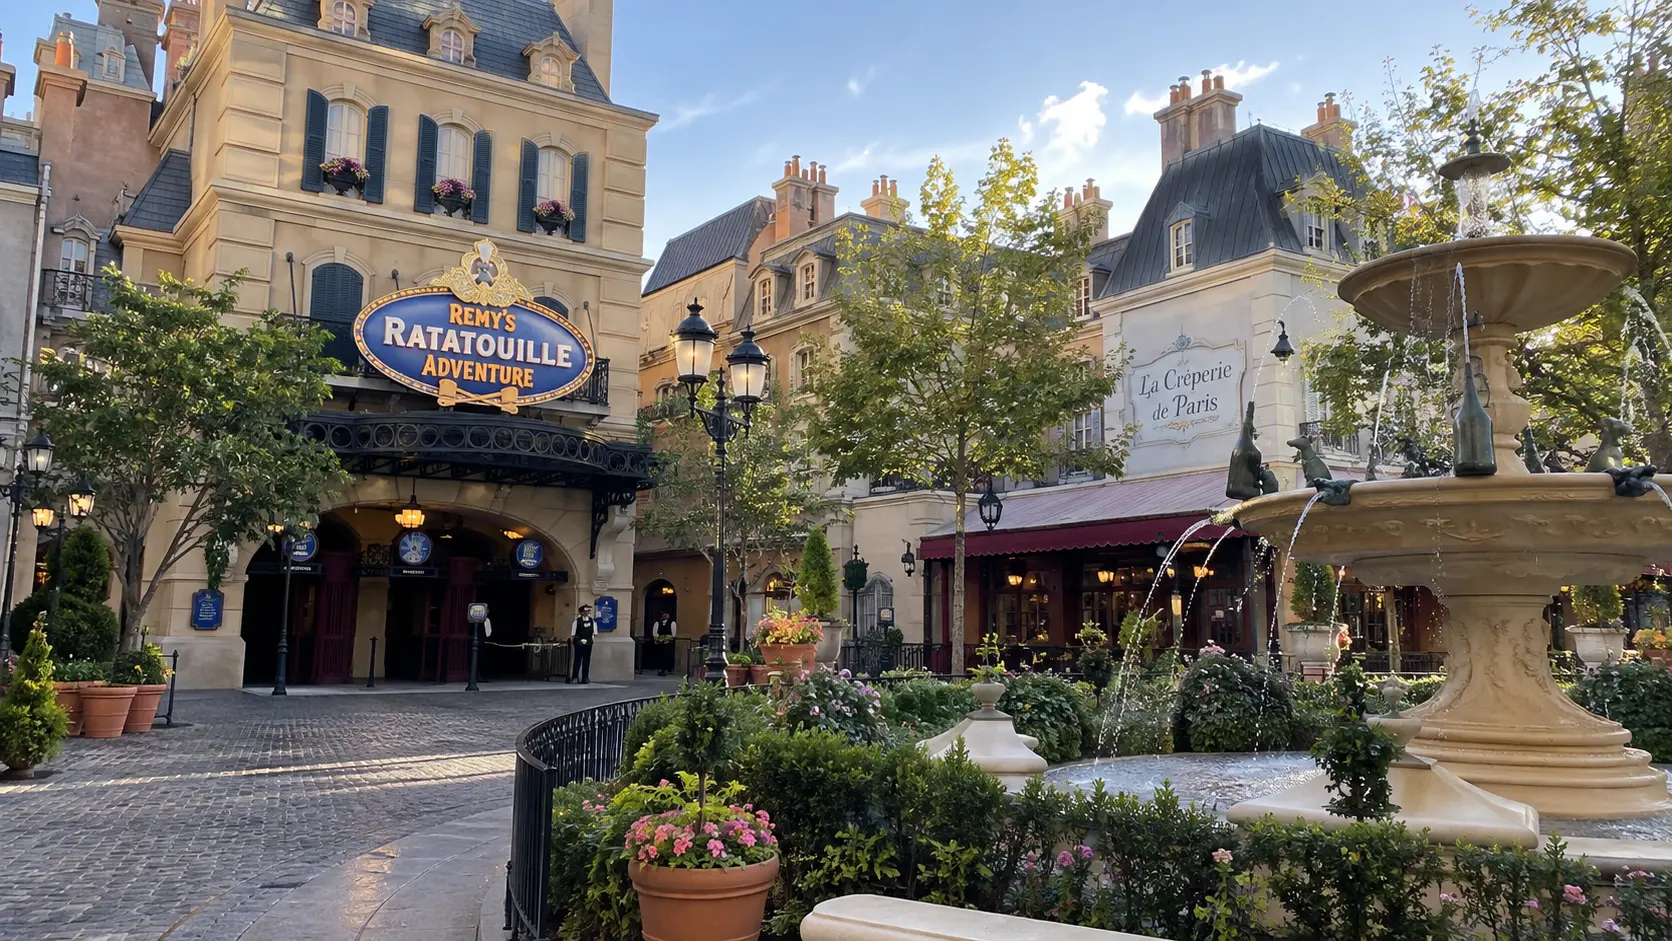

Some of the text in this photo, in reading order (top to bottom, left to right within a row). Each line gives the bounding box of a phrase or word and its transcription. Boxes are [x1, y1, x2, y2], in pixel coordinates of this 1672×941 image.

[449, 303, 516, 332] REMY'S
[383, 316, 572, 368] RATATOUILLE
[421, 354, 534, 388] ADVENTURE
[1139, 374, 1159, 399] La
[1152, 394, 1218, 421] de Paris
